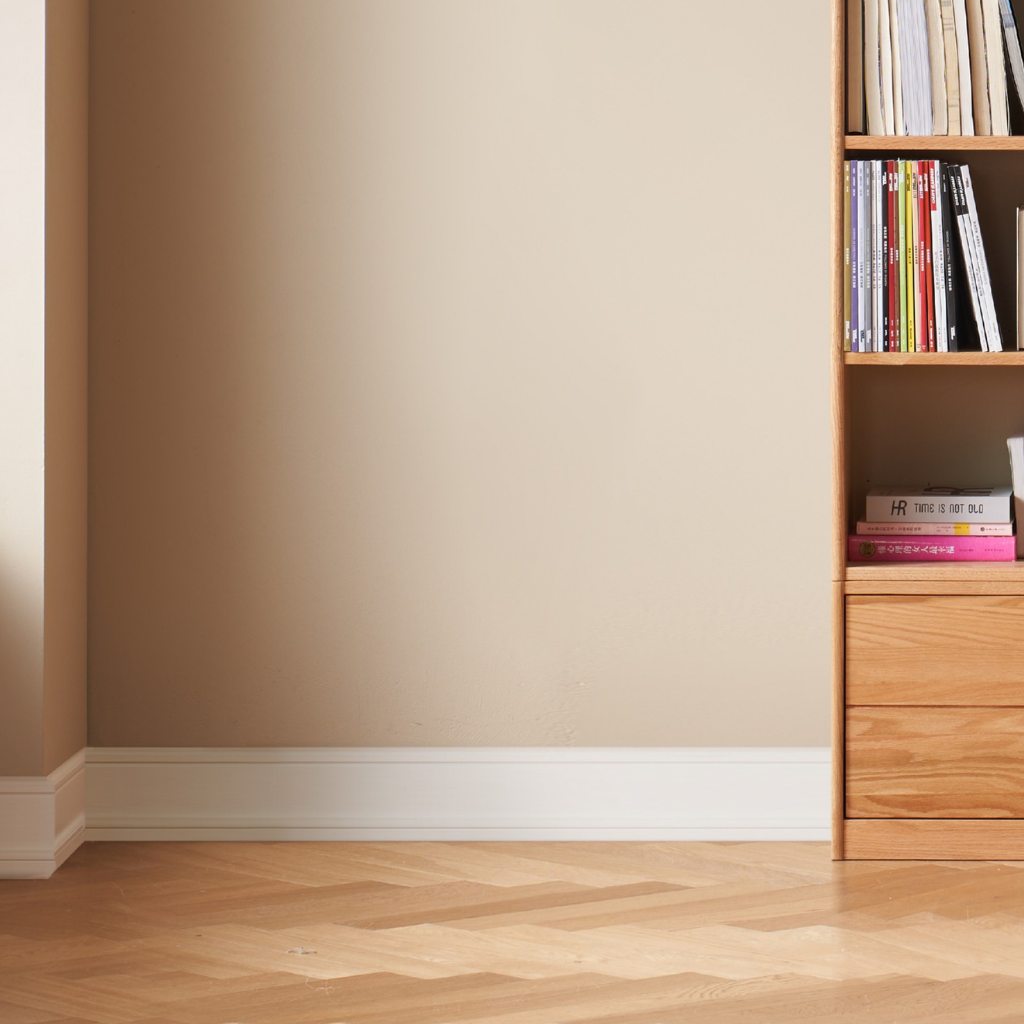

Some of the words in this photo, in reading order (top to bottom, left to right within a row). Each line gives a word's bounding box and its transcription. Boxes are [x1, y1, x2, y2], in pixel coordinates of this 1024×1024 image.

[890, 500, 907, 516] HR
[914, 503, 934, 513] TIME
[938, 503, 945, 513] IS
[949, 503, 964, 513] NOT
[968, 503, 984, 513] OLD
